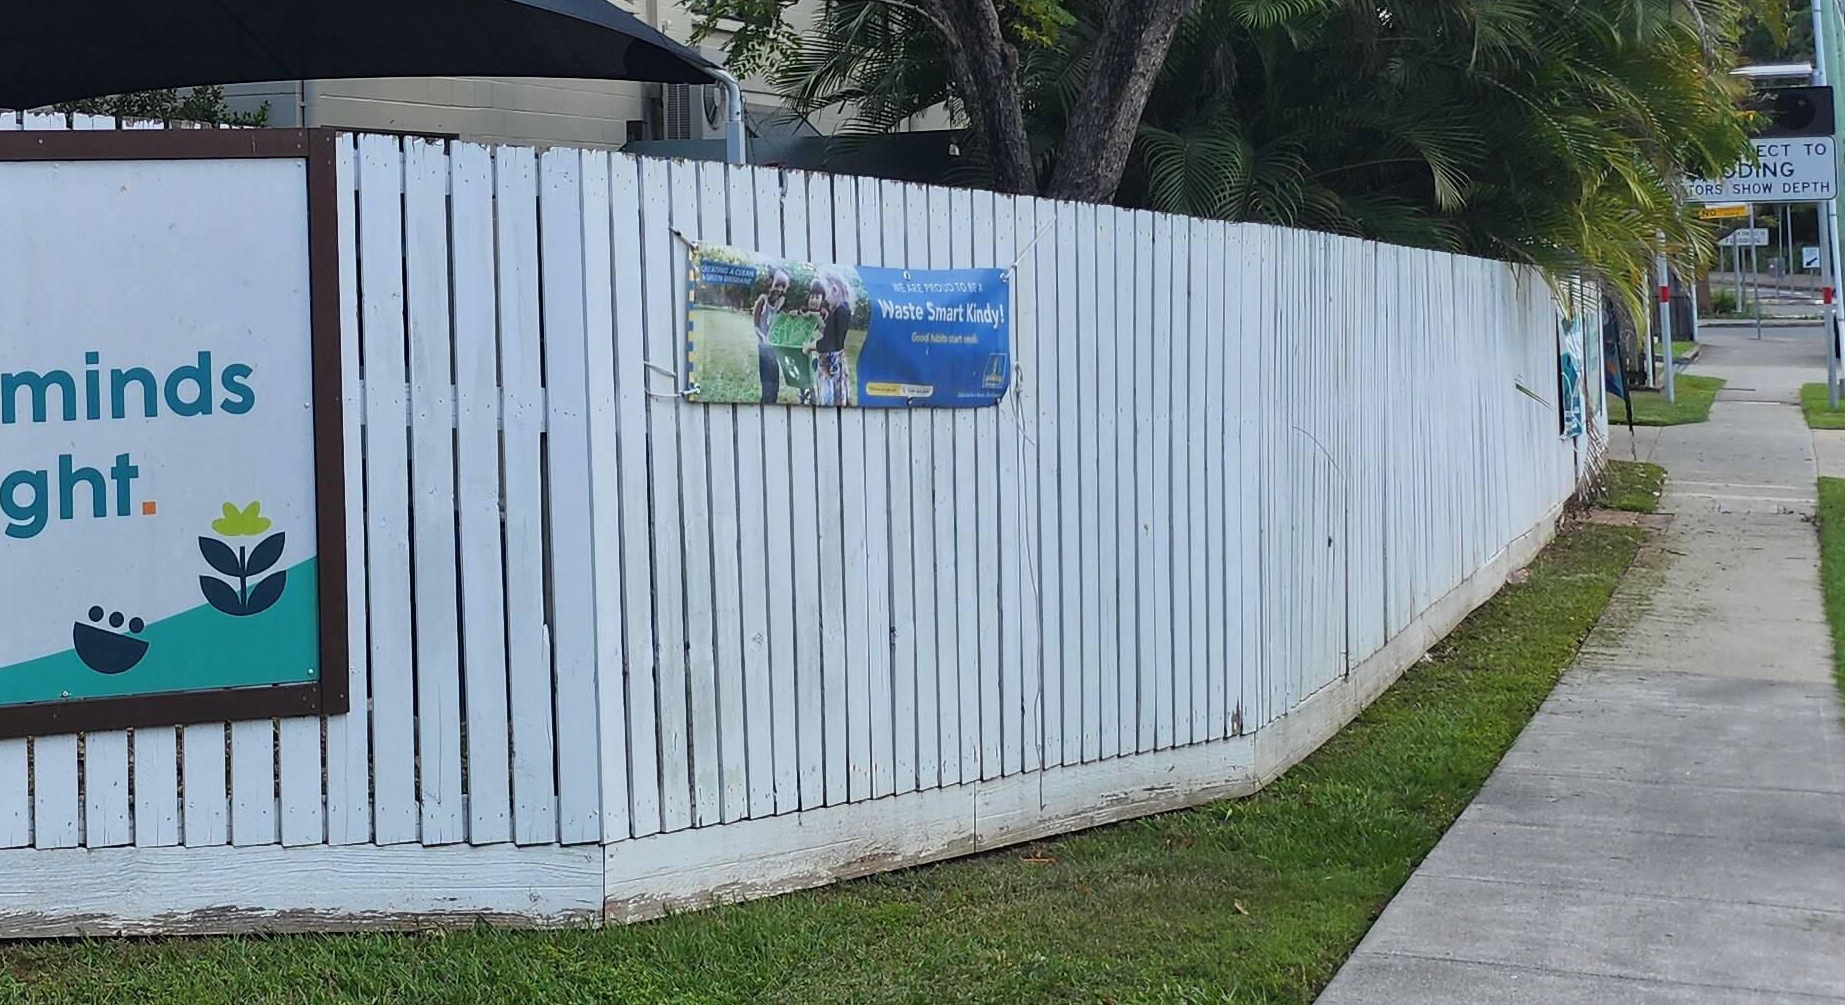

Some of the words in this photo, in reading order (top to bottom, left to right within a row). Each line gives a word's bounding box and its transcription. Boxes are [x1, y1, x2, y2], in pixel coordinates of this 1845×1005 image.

[1803, 143, 1826, 156] TO
[1732, 182, 1772, 194] SHOW
[1782, 182, 1829, 193] DEPTH
[892, 283, 904, 292] WE
[906, 283, 923, 293] ARE
[924, 283, 954, 293] PROUD
[955, 283, 967, 292] TO
[878, 299, 924, 320] Waste
[926, 301, 963, 322] Smart
[966, 303, 1004, 329] Kindy!
[1, 351, 255, 424] minds
